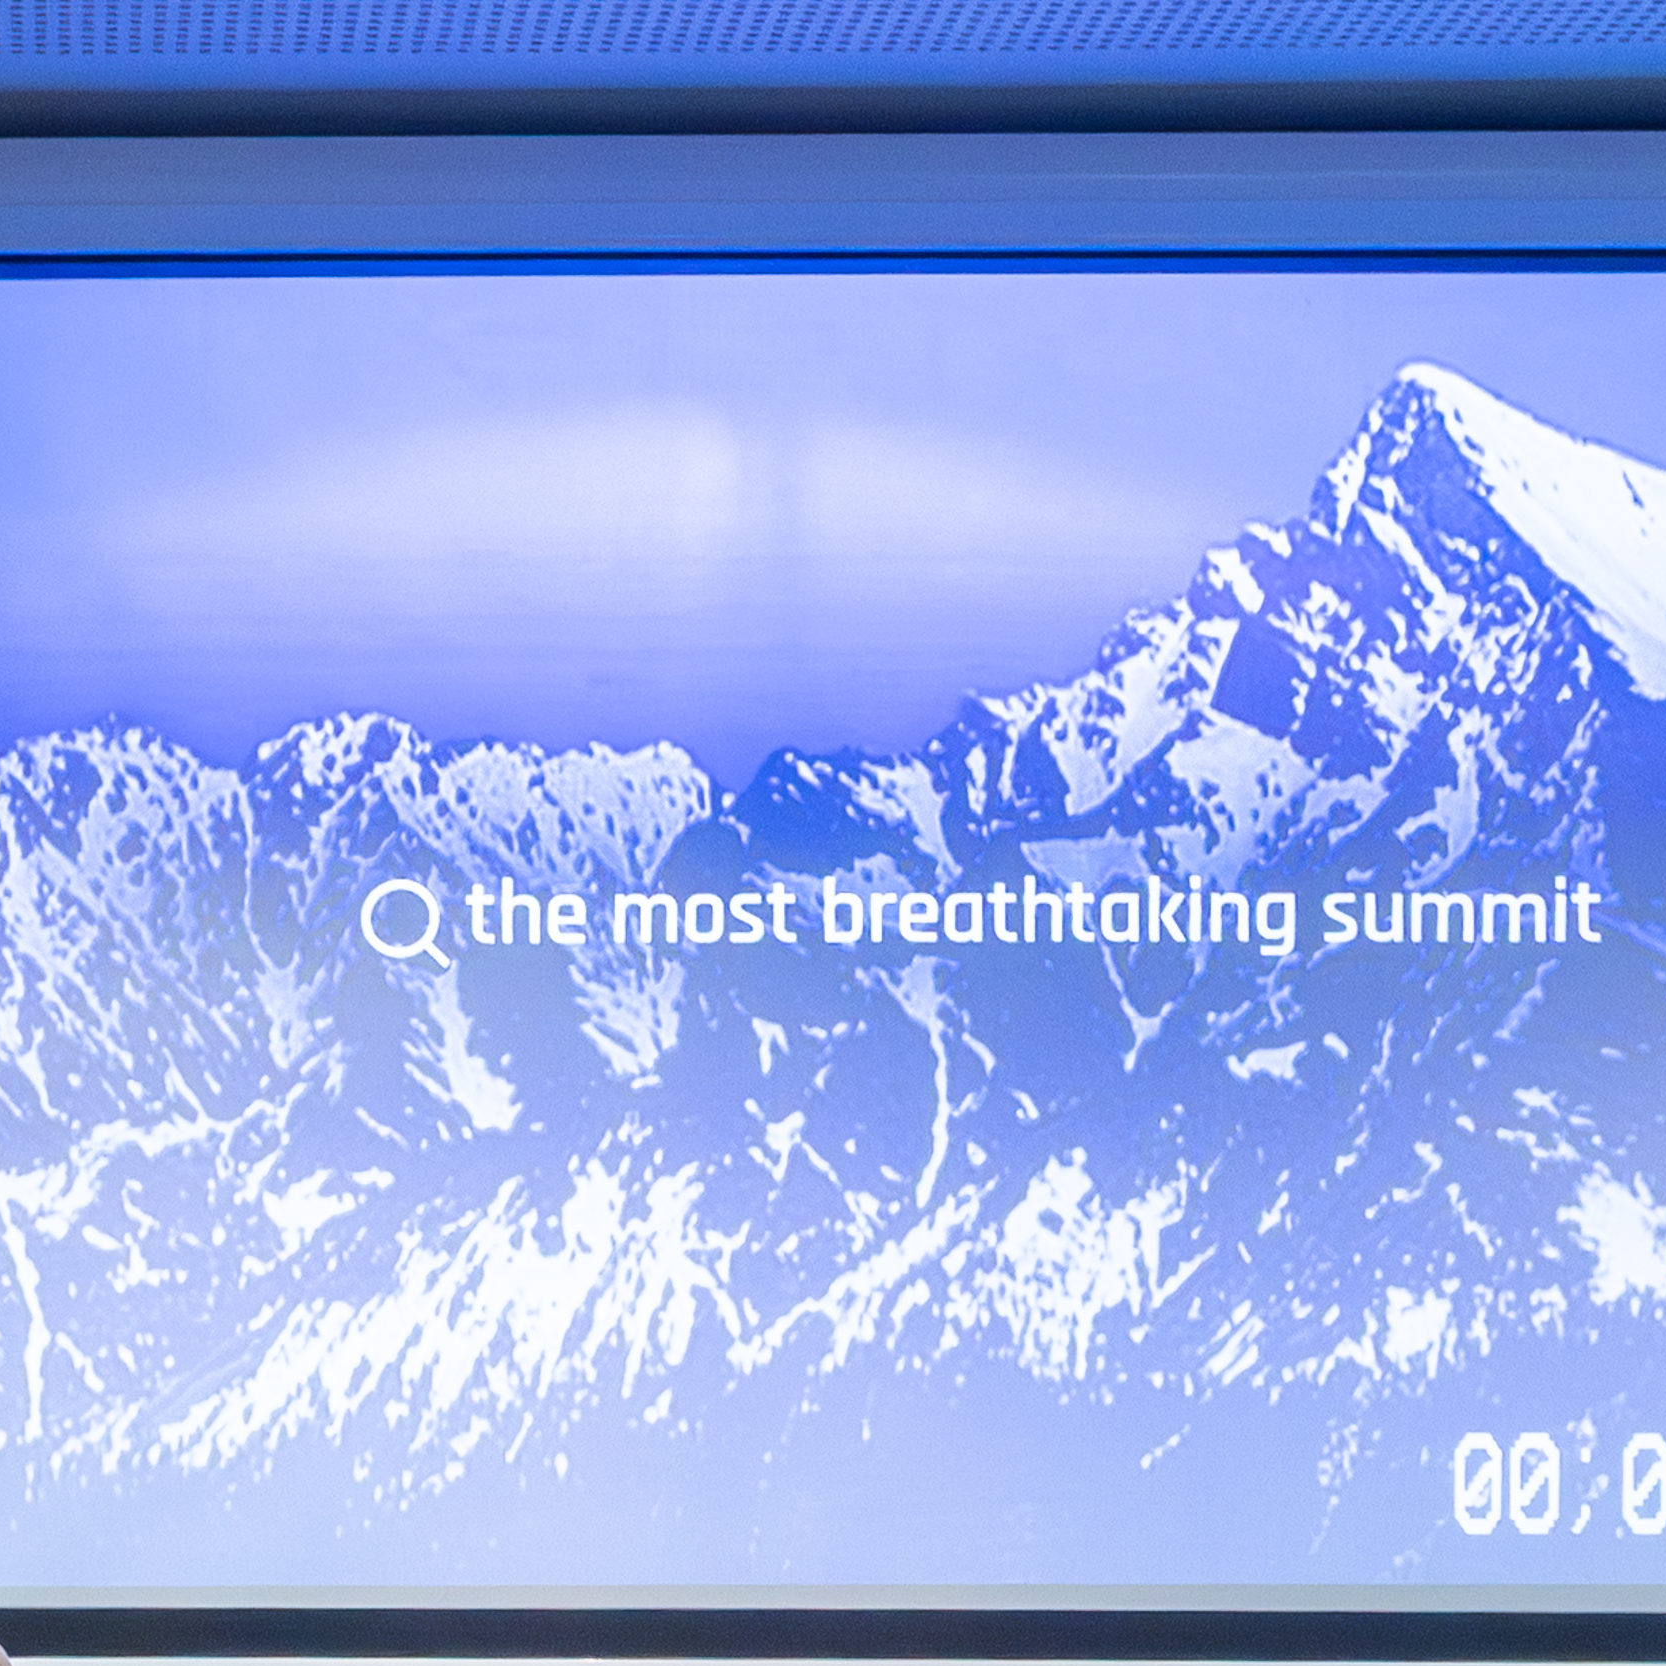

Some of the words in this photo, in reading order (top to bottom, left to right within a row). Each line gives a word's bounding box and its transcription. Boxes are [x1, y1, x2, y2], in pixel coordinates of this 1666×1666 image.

[465, 876, 587, 945] the
[612, 882, 798, 945] most
[822, 874, 1296, 956] breathtaking
[1322, 874, 1602, 944] summit
